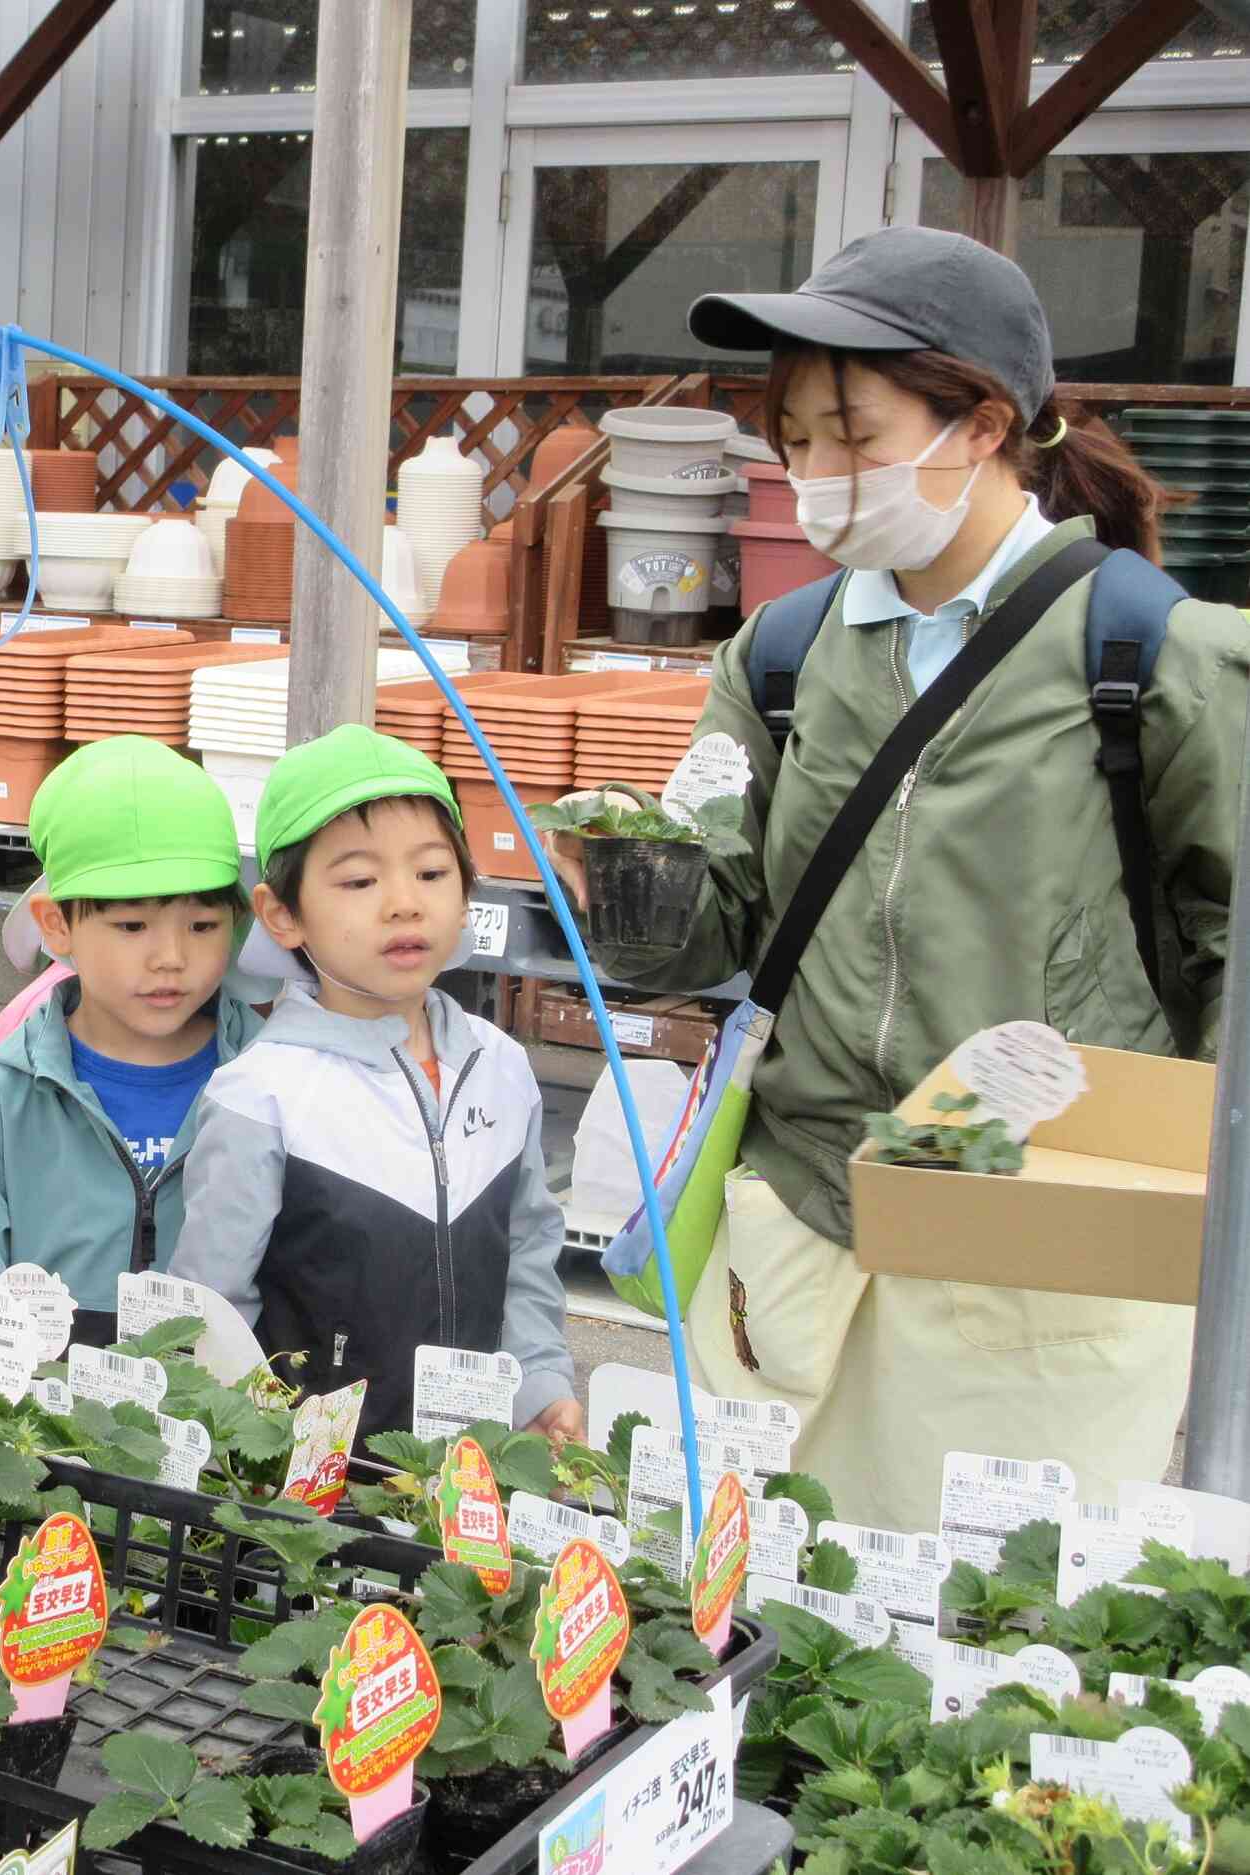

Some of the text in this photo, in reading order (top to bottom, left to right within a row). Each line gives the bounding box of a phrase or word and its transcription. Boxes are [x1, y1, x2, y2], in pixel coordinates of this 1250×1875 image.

[469, 906, 505, 932] アグリ
[32, 1578, 87, 1617] 宝交早生
[356, 1667, 412, 1726] 宝交早生
[622, 1738, 711, 1824] イチゴ苗 宝交早生
